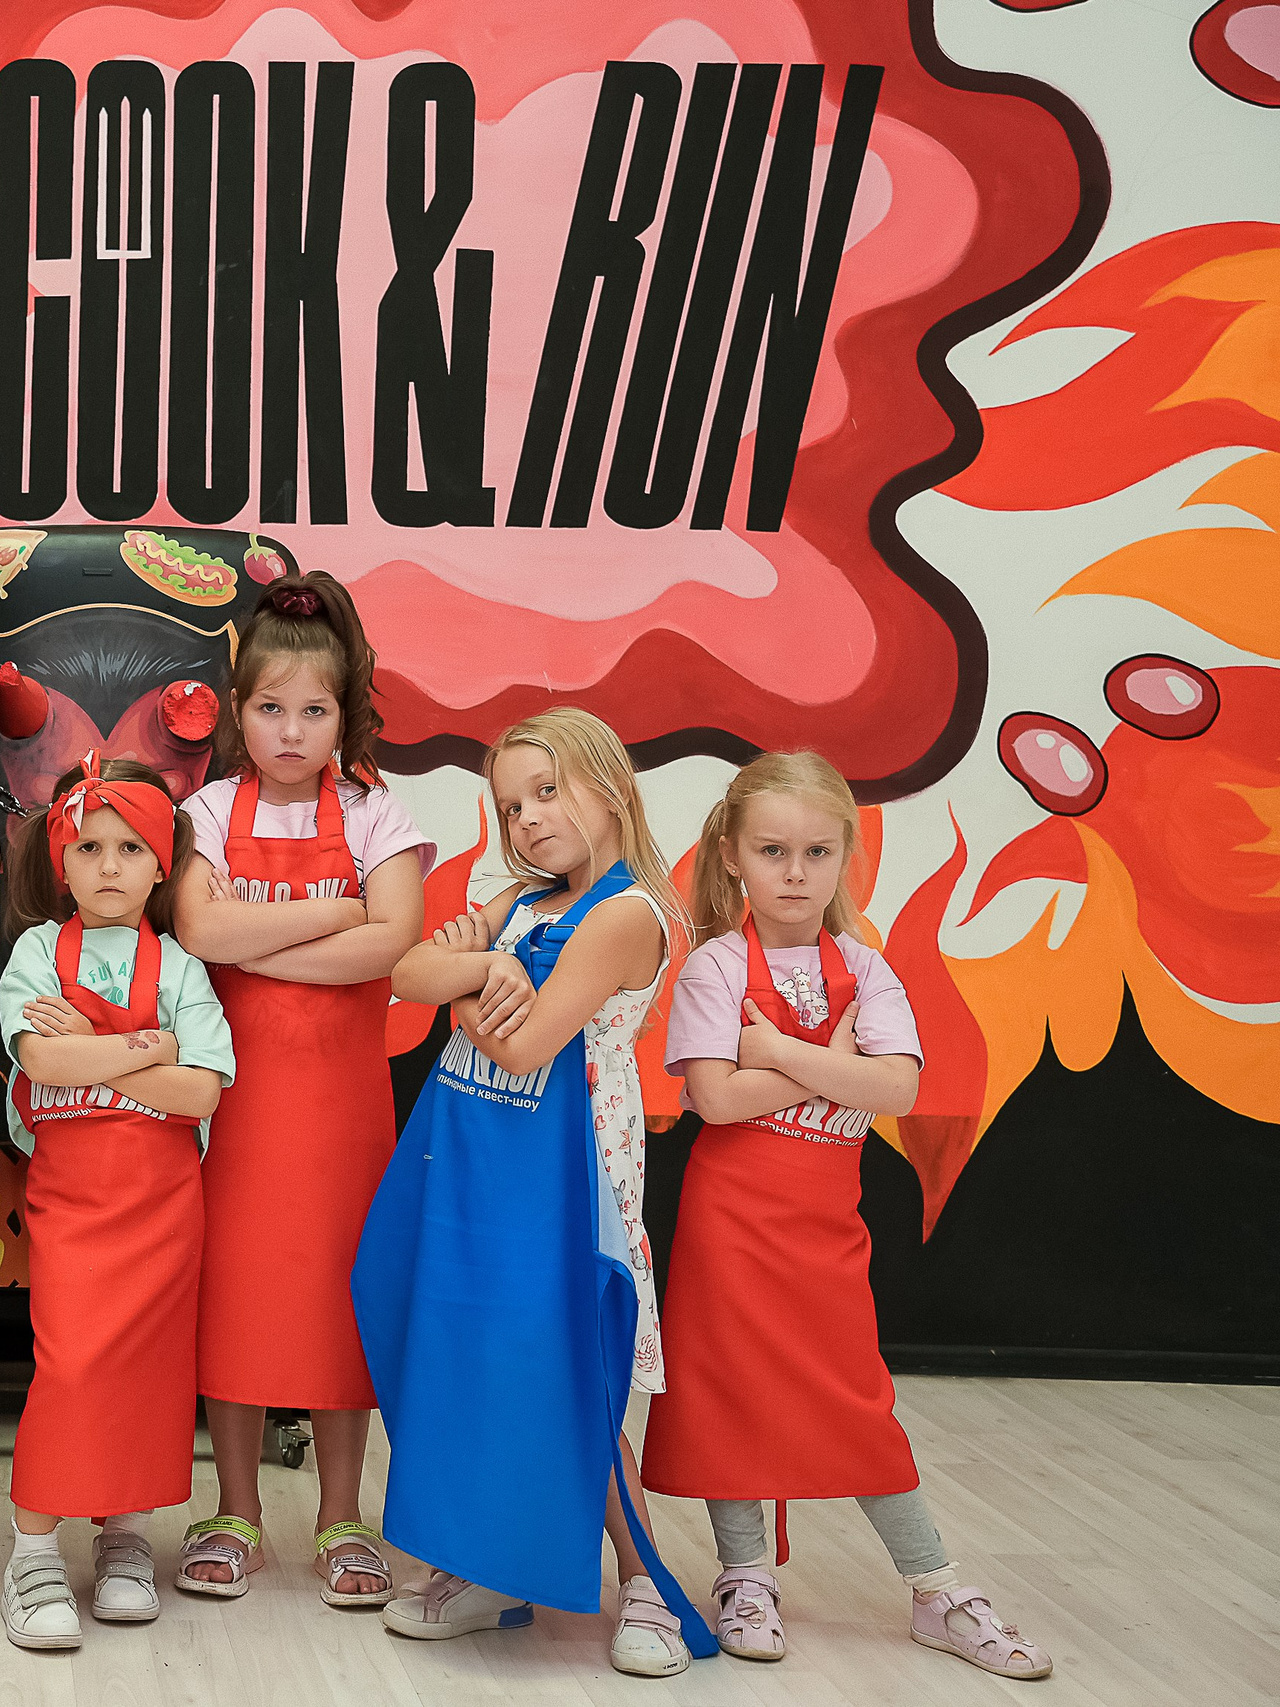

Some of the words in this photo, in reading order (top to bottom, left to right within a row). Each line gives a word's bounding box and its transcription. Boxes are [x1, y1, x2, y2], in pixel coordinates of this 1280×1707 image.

[371, 60, 496, 528] &
[505, 60, 885, 533] RUN
[477, 1088, 540, 1113] квест-шоу
